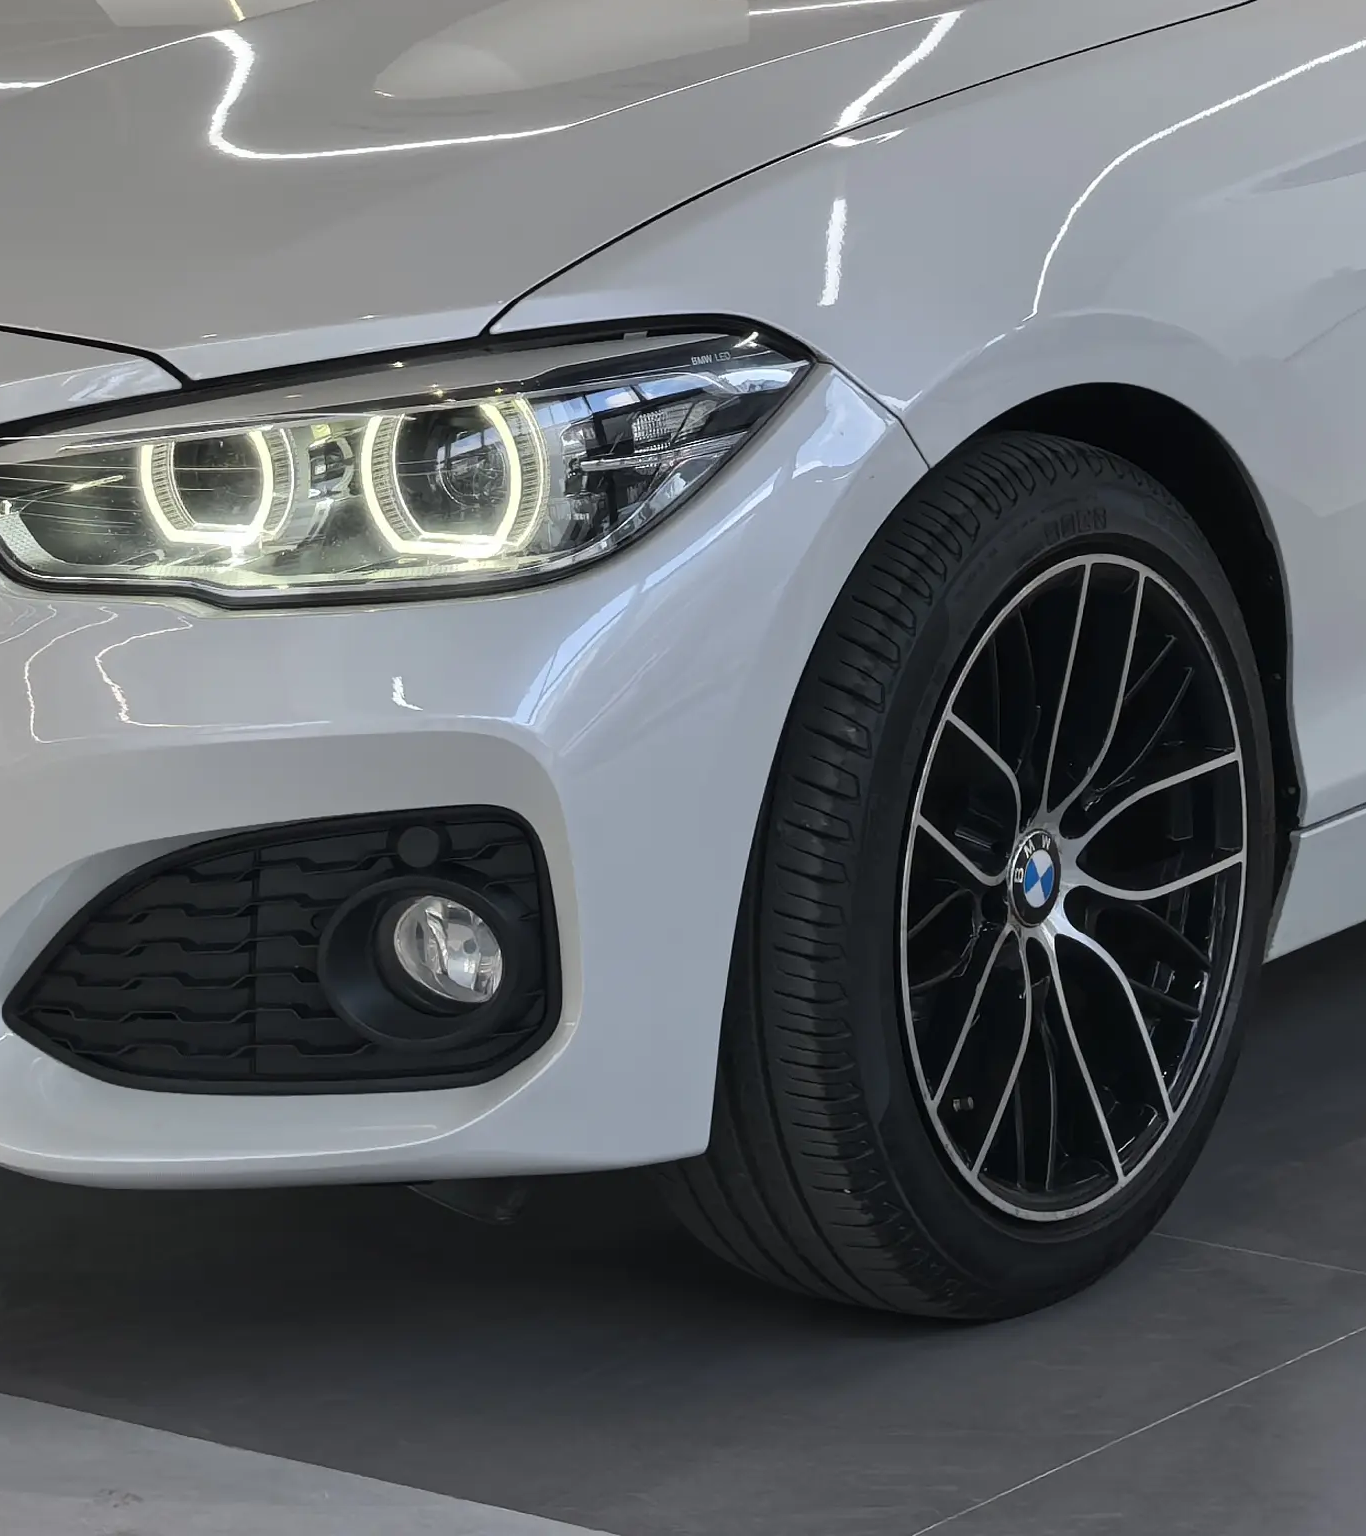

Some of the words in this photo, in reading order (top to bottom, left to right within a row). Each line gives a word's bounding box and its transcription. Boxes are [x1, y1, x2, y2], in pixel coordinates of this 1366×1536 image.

[690, 354, 713, 366] BMW
[714, 350, 731, 363] LED
[1014, 834, 1051, 884] BMW
